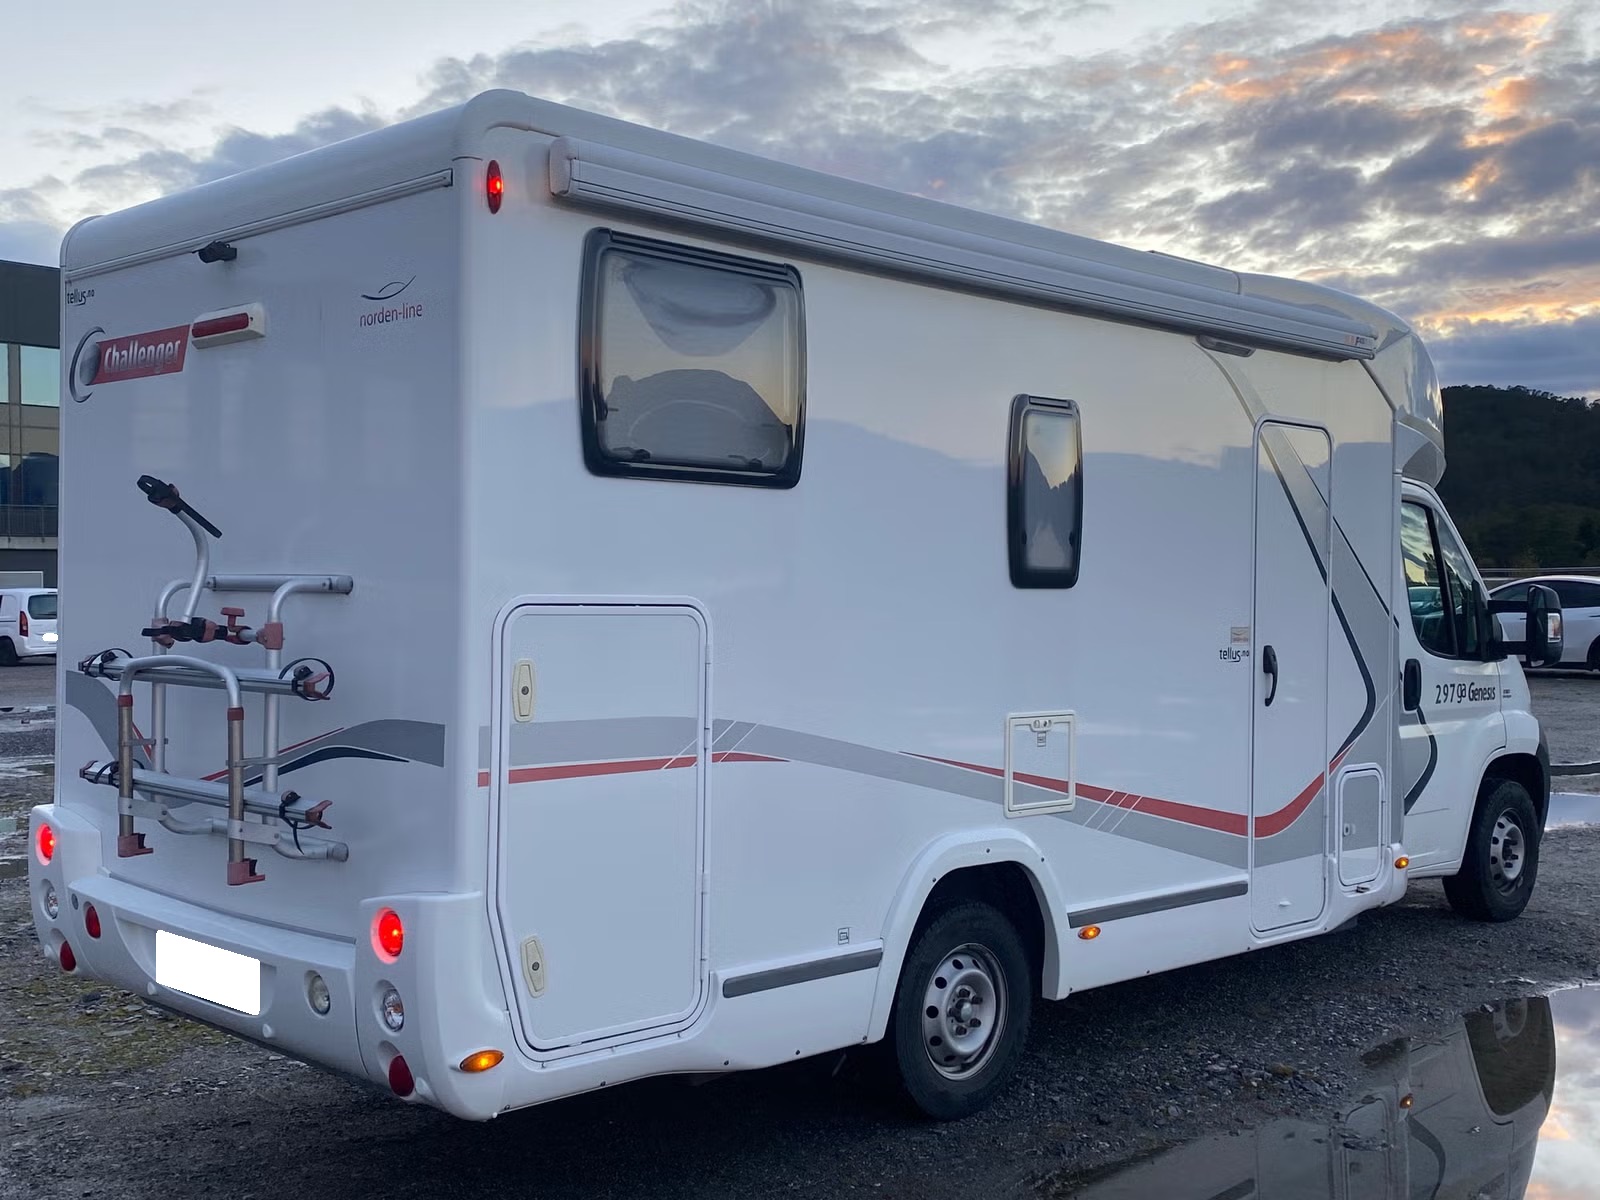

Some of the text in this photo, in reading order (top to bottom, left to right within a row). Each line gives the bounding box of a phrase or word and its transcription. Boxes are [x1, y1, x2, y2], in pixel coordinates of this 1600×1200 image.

[67, 288, 95, 306] tellus.no
[360, 302, 423, 328] norden-line
[103, 339, 181, 374] Challenger
[1468, 682, 1496, 702] Genesis
